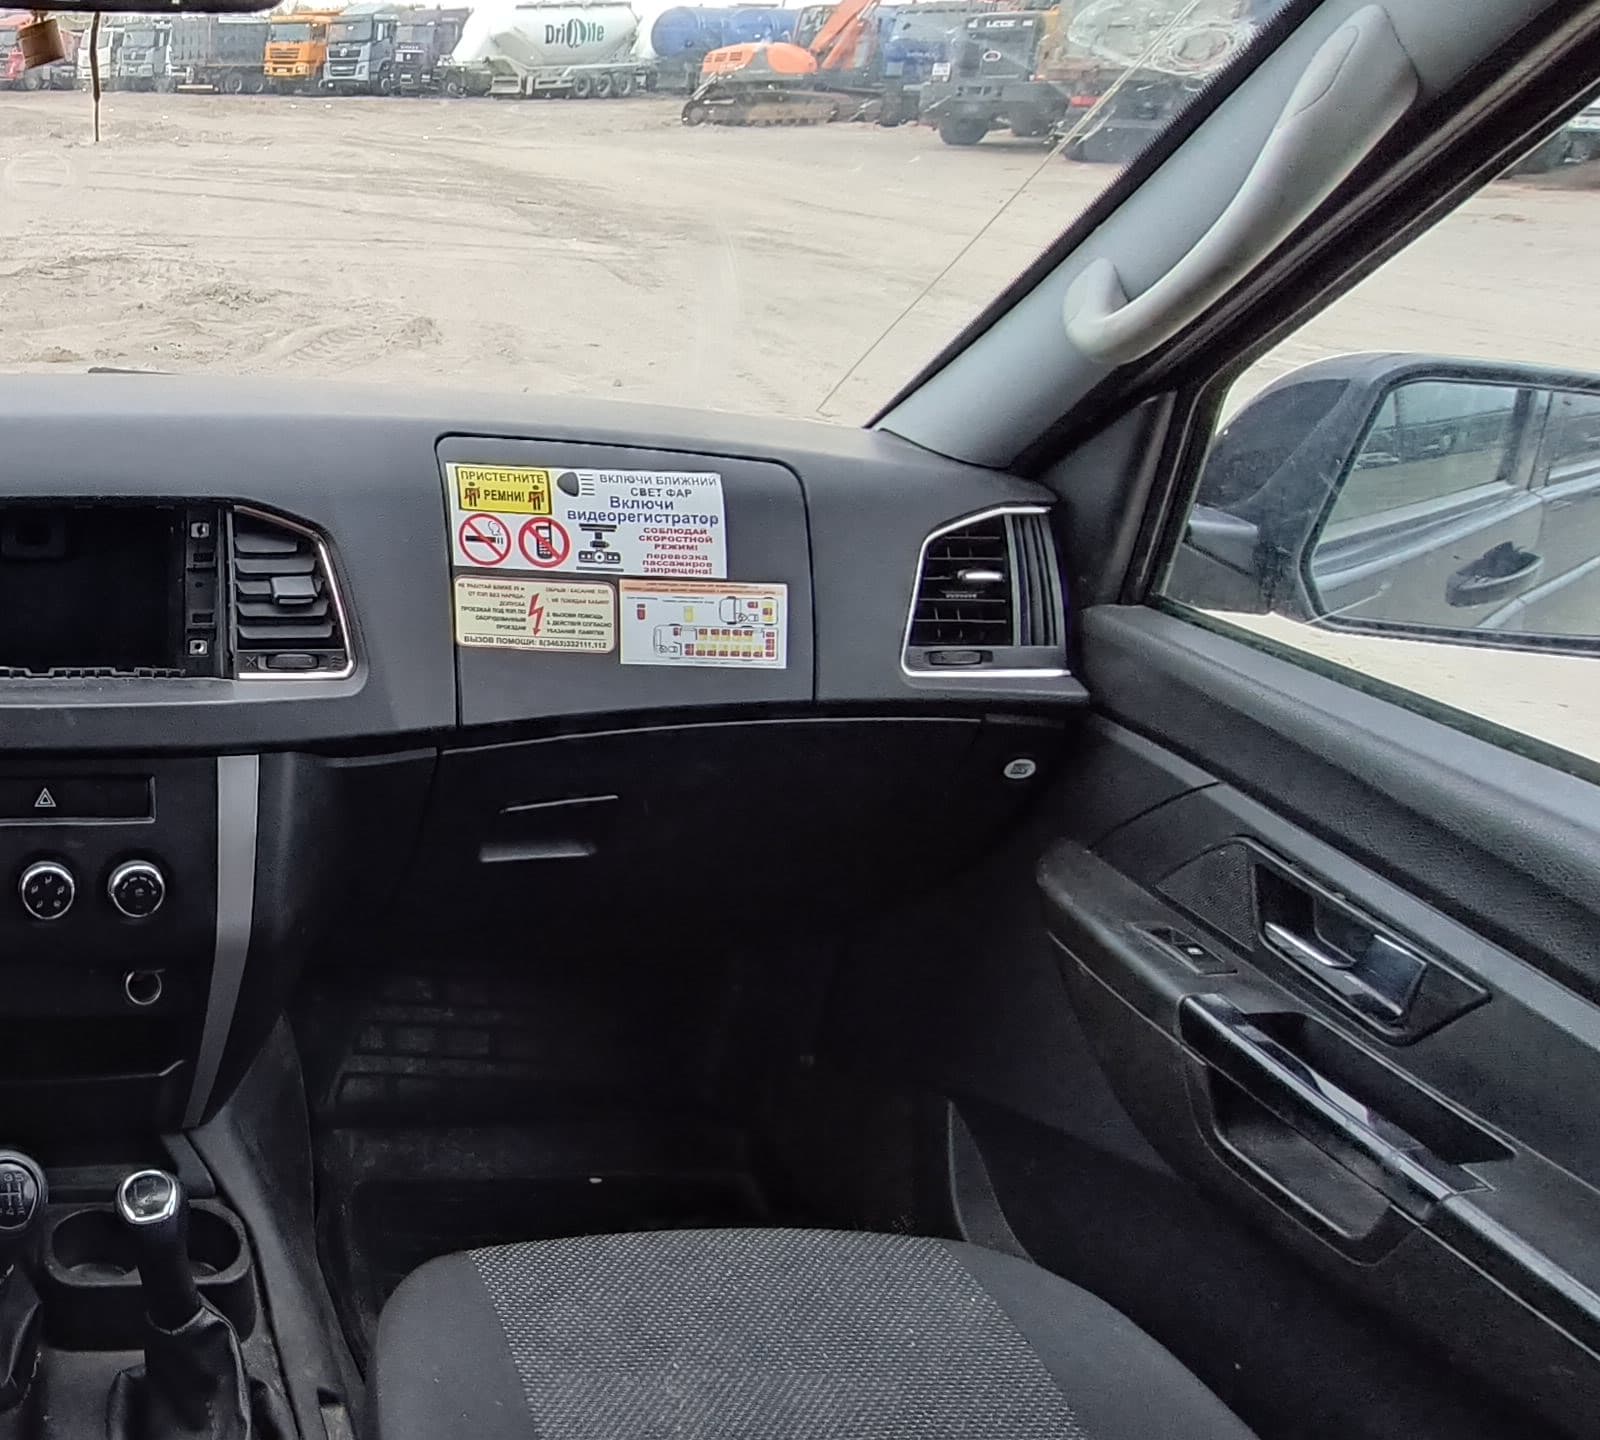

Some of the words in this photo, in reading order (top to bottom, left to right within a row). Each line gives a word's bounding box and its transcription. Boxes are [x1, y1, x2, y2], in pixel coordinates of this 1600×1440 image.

[460, 470, 545, 484] ПРИСТЕГНИТЕ
[599, 474, 653, 485] ВКЛЮЧИ
[656, 475, 717, 486] БЛИЖНИЙ
[483, 489, 526, 502] РЕМНИ!
[630, 487, 661, 497] СВЕТ
[665, 488, 692, 498] ФАР
[609, 496, 674, 511] Включи
[567, 510, 719, 527] видеорегистратор
[643, 526, 708, 535] СОБЛЮДАЙ
[638, 534, 714, 543] СКОРОСТНОЙ
[654, 543, 698, 551] РЕЖИМ!
[646, 553, 708, 561] перевозка
[642, 560, 713, 568] пассажиров
[643, 567, 713, 576] запрещена!
[464, 635, 494, 644] ВЫЗОВ
[496, 636, 537, 646] ПОМОЩИ:
